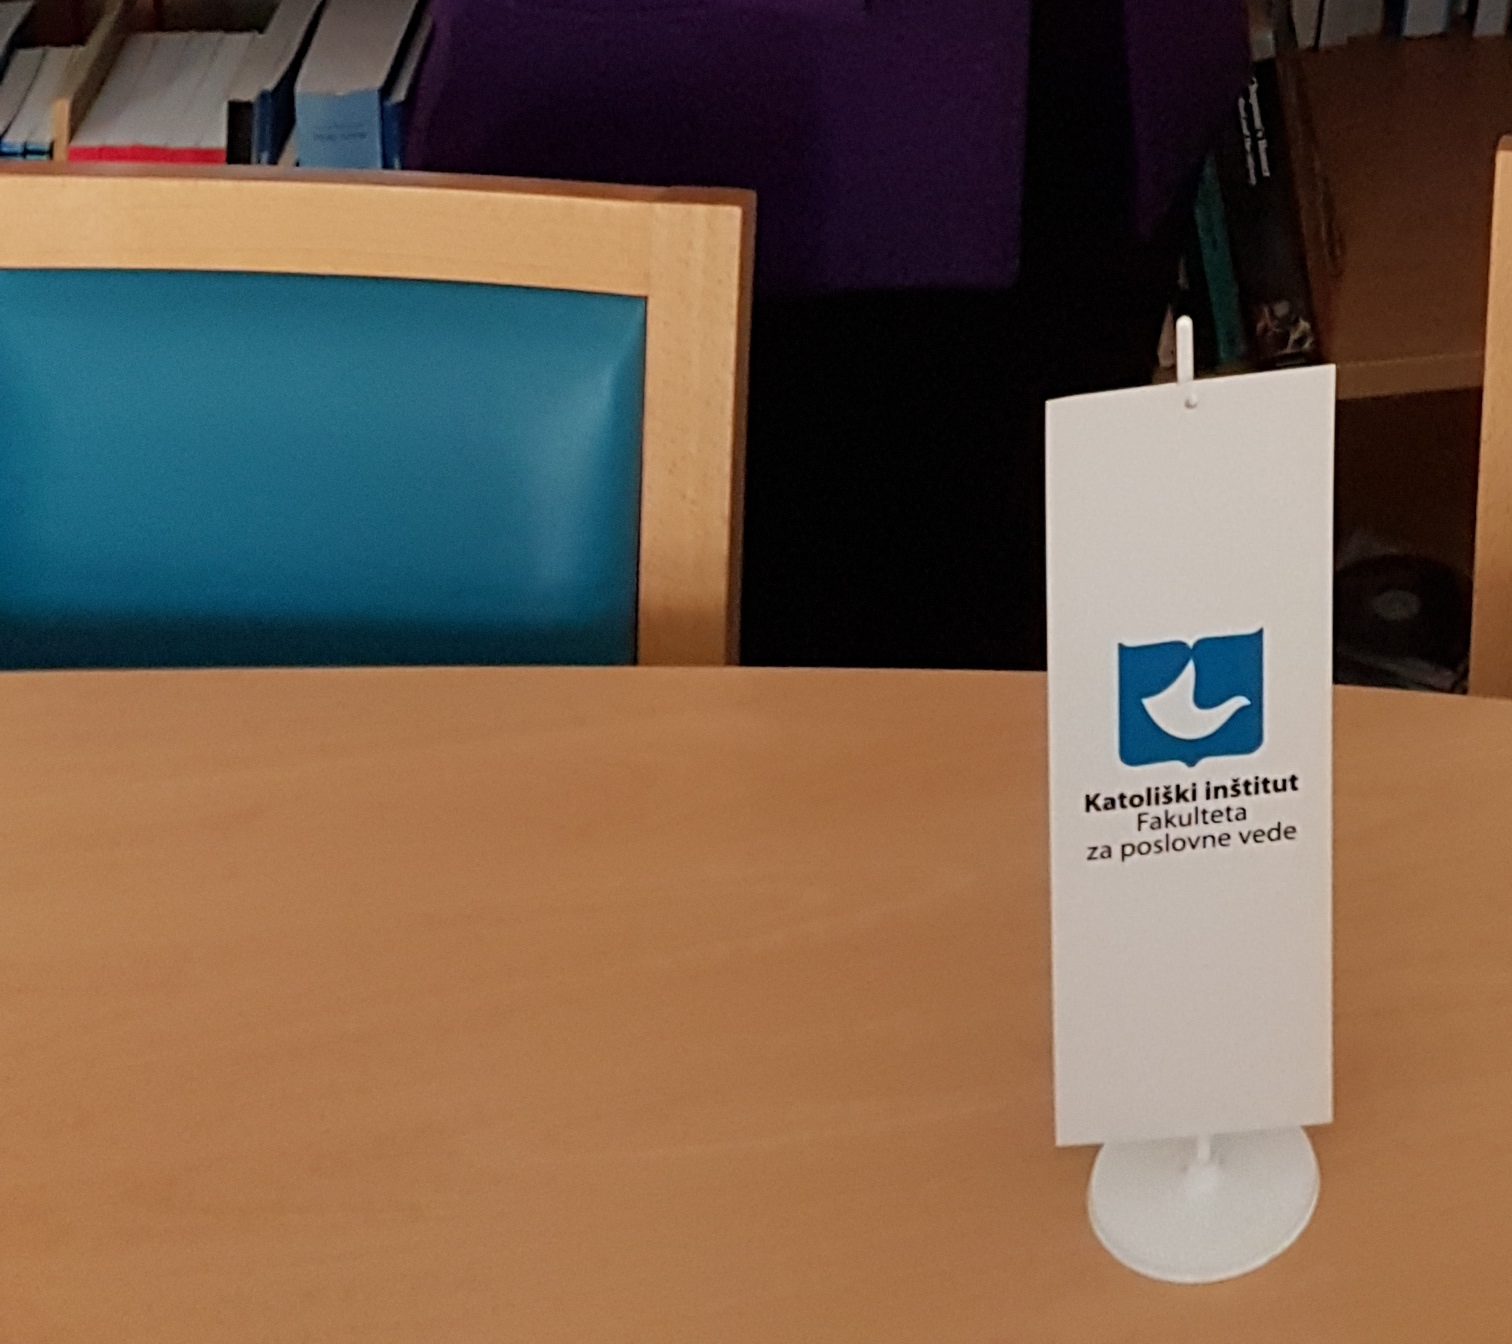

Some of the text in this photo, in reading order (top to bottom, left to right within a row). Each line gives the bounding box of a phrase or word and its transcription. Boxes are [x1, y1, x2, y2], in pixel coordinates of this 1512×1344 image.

[1085, 774, 1299, 812] Katoliški inštitut
[1137, 806, 1247, 831] Fakulteta
[1087, 822, 1297, 861] za poslovne vede
